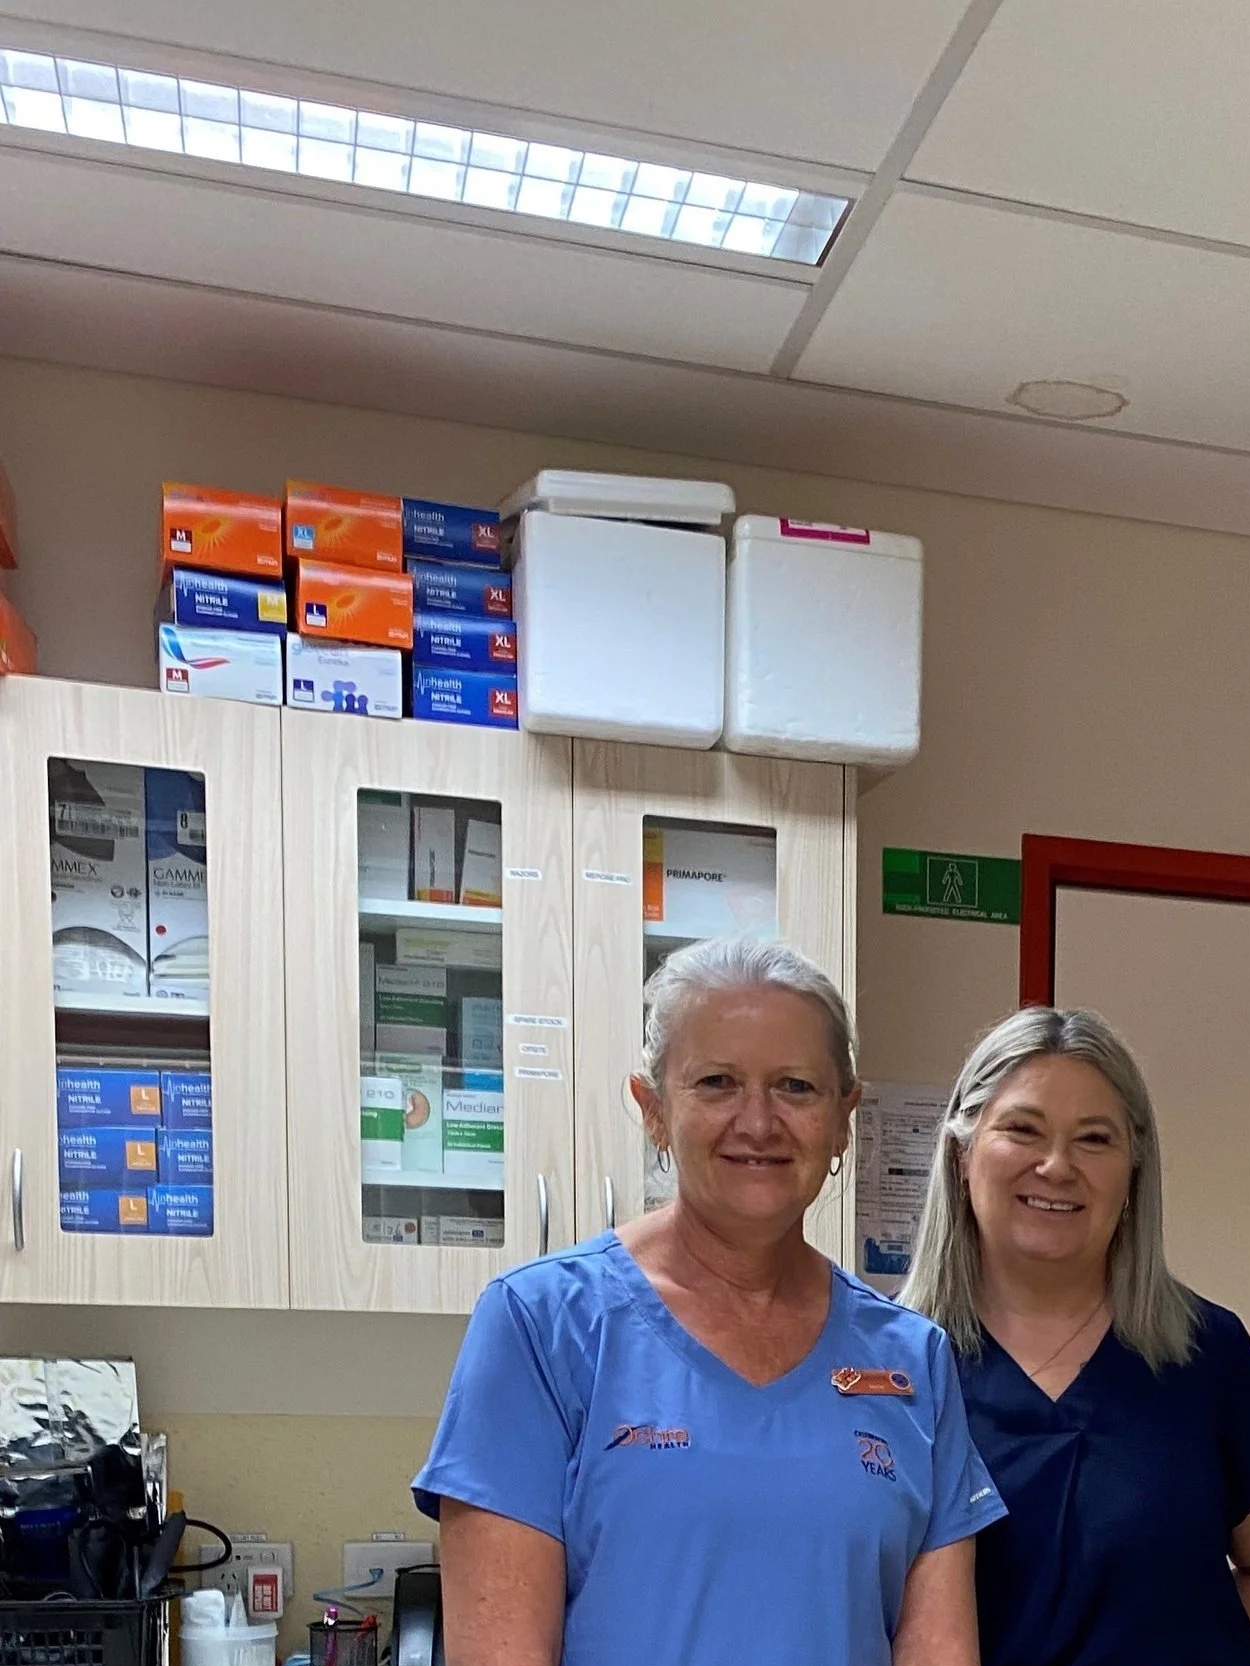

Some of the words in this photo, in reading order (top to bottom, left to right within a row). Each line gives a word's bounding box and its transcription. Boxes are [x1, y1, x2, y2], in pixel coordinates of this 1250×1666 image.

[176, 531, 186, 541] M
[297, 527, 310, 538] XL
[478, 525, 494, 538] XL
[195, 594, 228, 607] NITRILE
[490, 588, 506, 602] XL
[313, 605, 320, 615] L
[431, 635, 461, 648] NITRILE
[495, 634, 511, 648] XL
[172, 669, 183, 680] M
[431, 691, 462, 704] NITRILE
[495, 690, 511, 705] XL
[666, 868, 724, 883] PRIMAPORE
[68, 1094, 101, 1104] NITRILE
[141, 1088, 150, 1100] L
[64, 1150, 97, 1160] NITRILE
[137, 1144, 145, 1156] L
[178, 1153, 210, 1163] NITRILE
[129, 1199, 138, 1211] L
[166, 1208, 198, 1218] NITRILE
[650, 1441, 689, 1450] HEALTH
[858, 1438, 894, 1468] 20
[860, 1460, 897, 1482] YEARS
